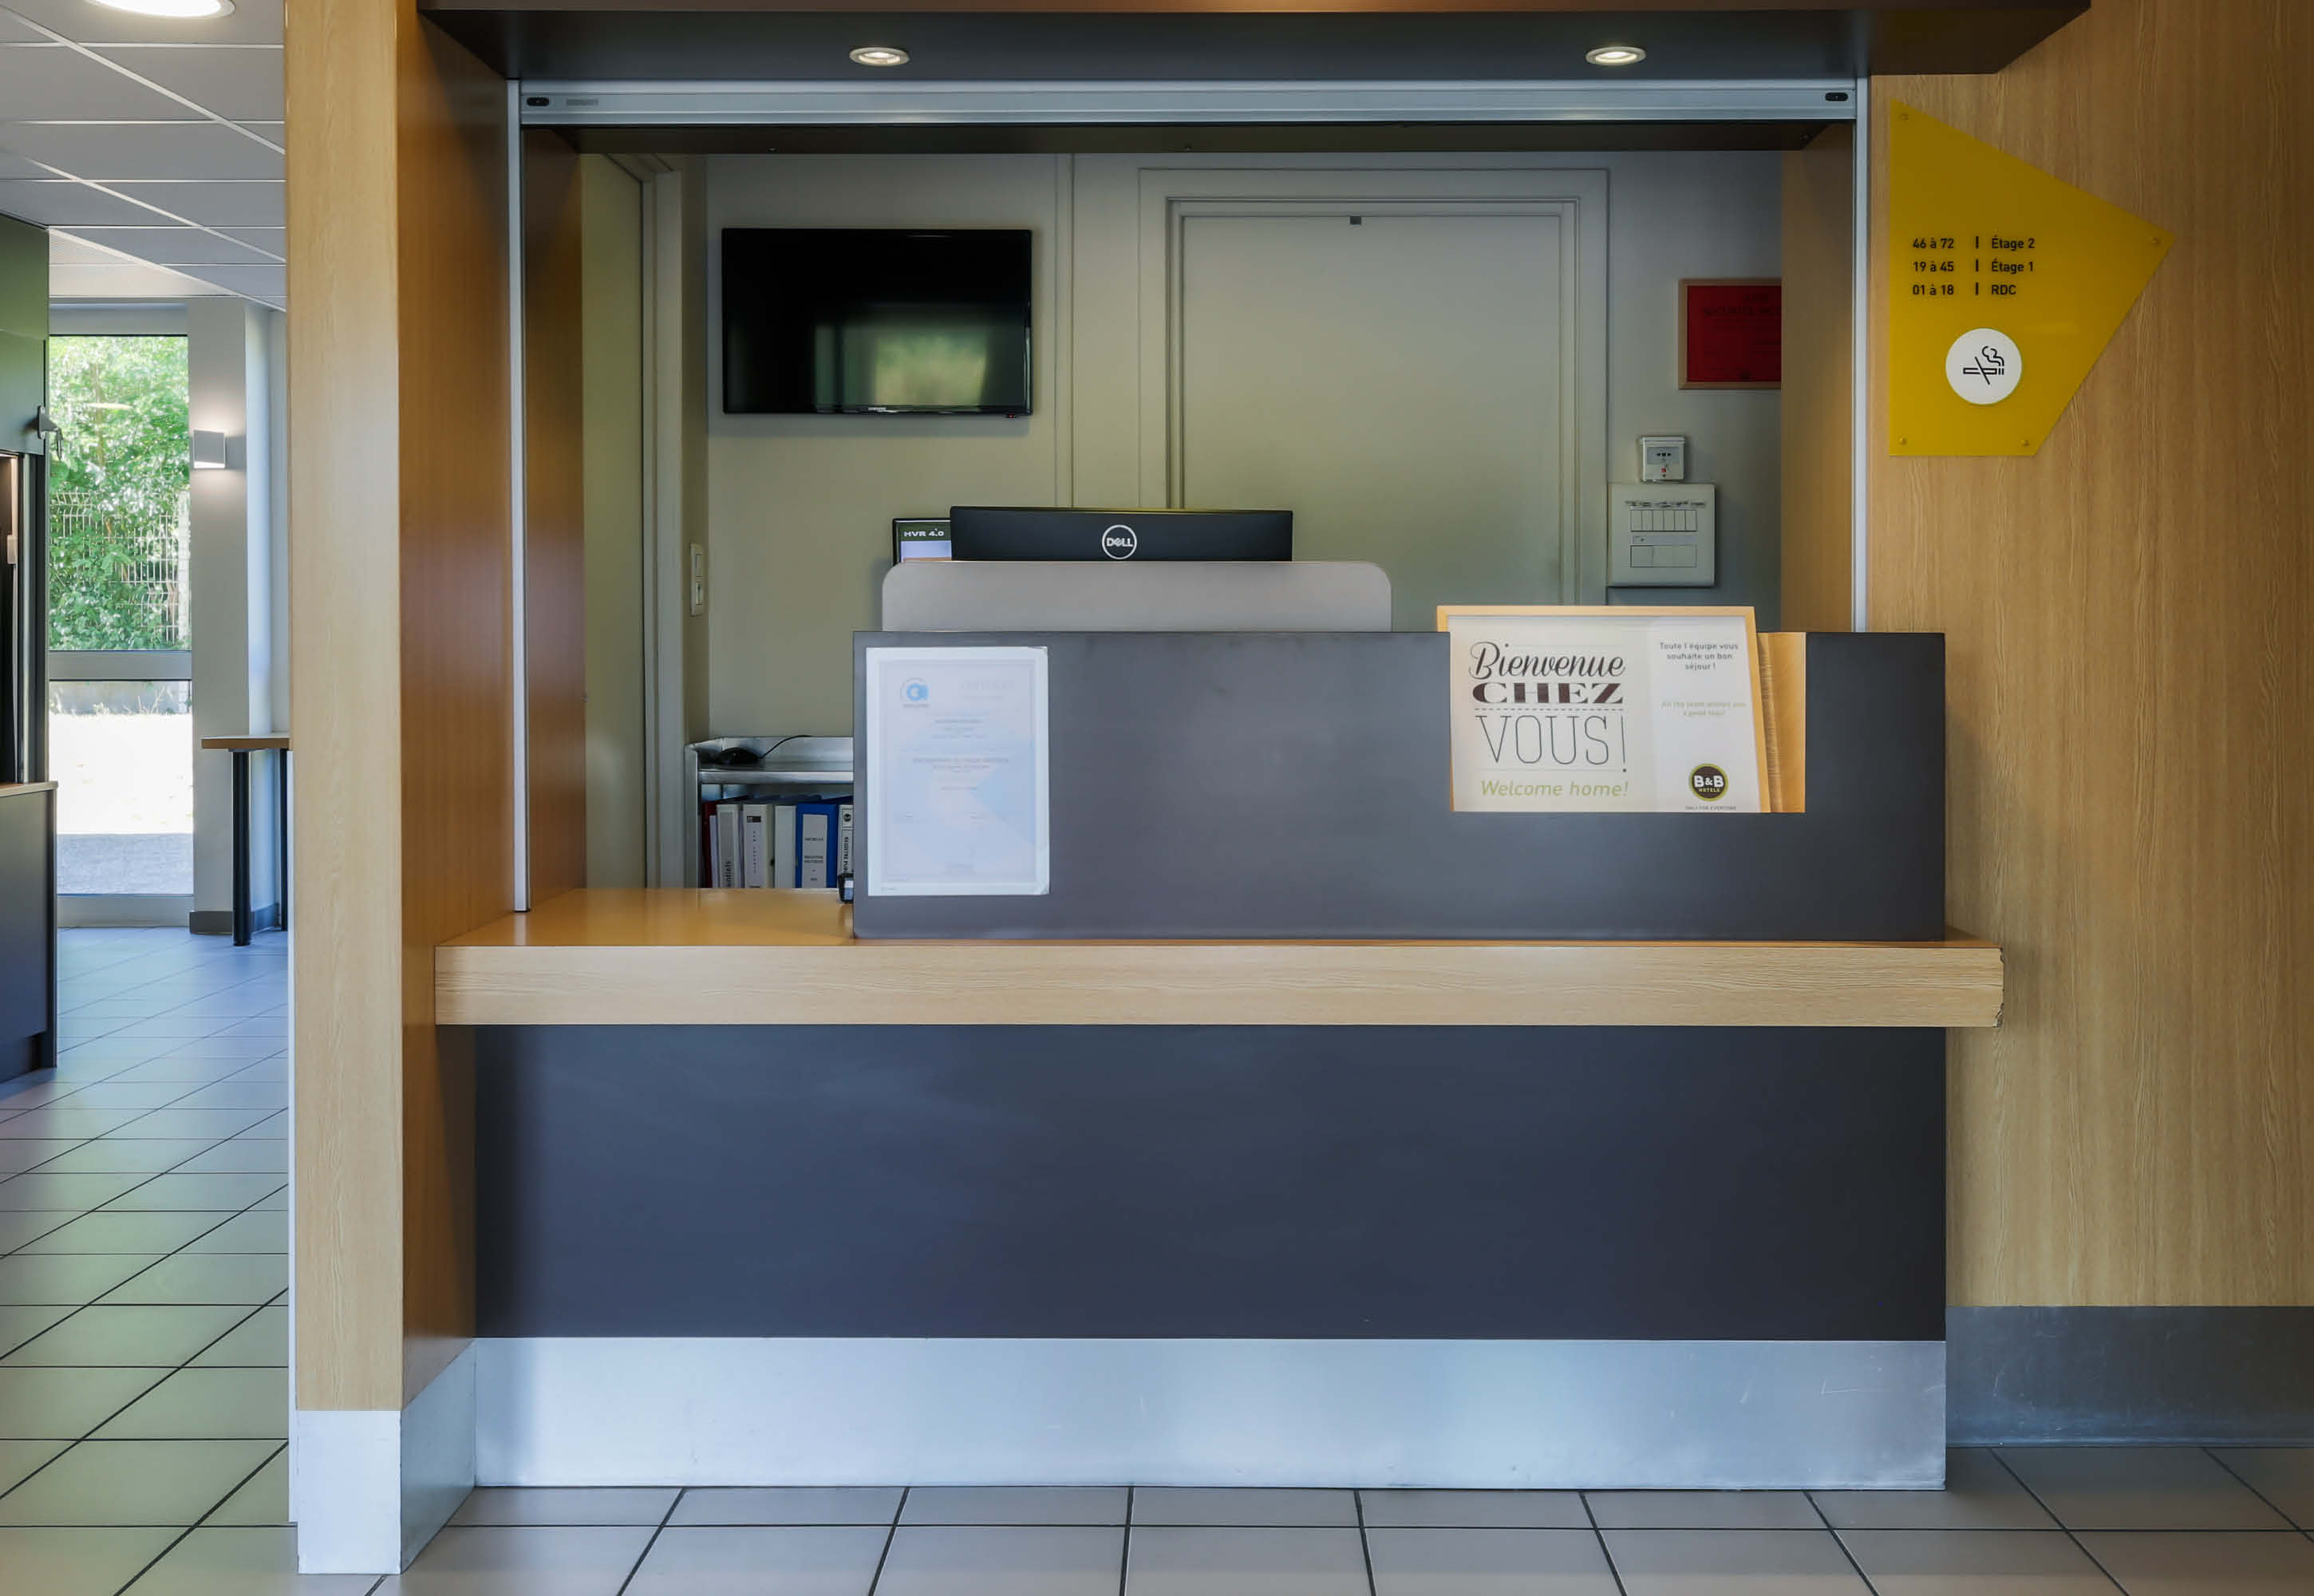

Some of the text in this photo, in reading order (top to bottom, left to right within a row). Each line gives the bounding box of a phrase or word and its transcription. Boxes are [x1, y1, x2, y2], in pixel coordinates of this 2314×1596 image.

[1913, 235, 2036, 251] 46 à 72 Étage 2
[1913, 259, 2033, 275] 19 à 45 Étage 1
[1913, 284, 2016, 295] 01 à 18 RDC
[1106, 537, 1133, 547] DELL
[1660, 642, 1682, 650] Toute
[1469, 642, 1625, 680] Bienvenue
[1684, 662, 1712, 671] séjour
[1472, 682, 1623, 703] CHEZ
[1480, 780, 1629, 797] Welcome home!
[1694, 775, 1724, 788] B&B
